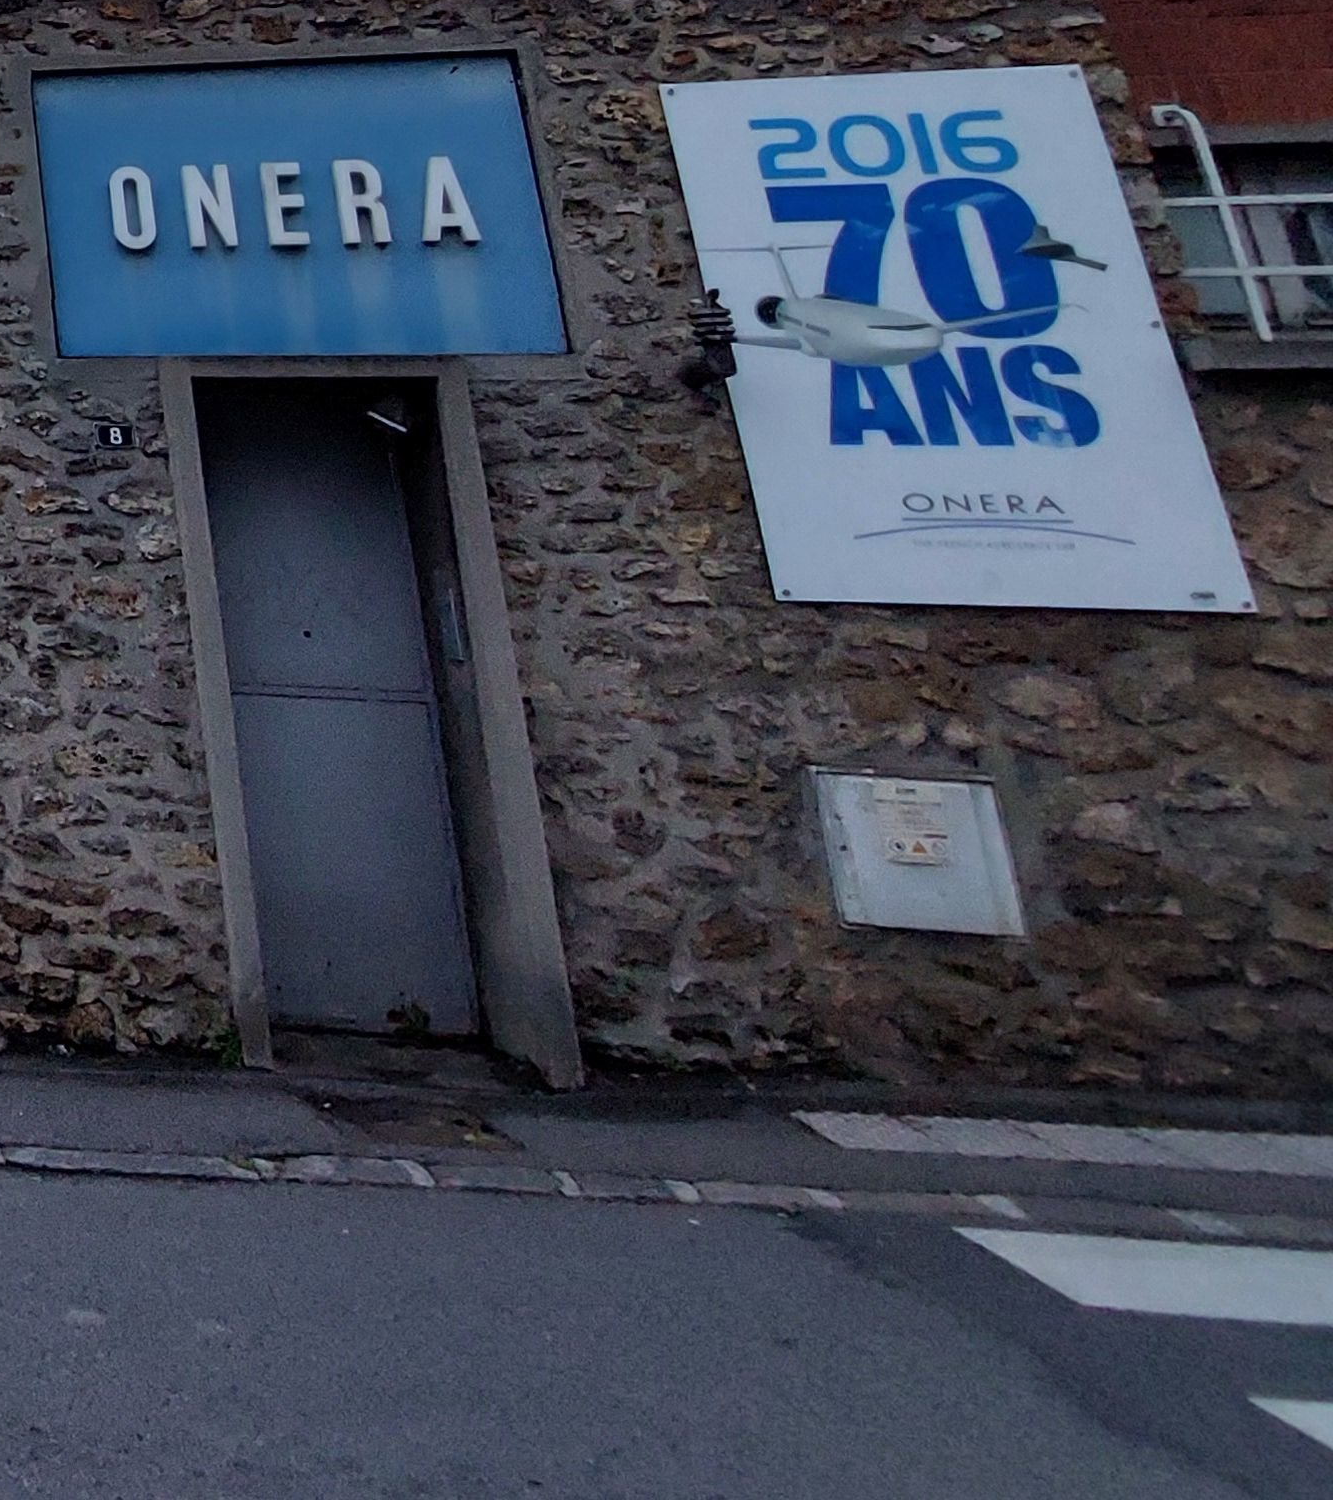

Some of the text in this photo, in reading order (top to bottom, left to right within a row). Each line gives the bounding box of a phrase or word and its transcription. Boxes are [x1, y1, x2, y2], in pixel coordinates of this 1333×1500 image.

[748, 109, 1019, 180] 2016
[108, 155, 483, 251] ONERA
[764, 177, 1060, 339] 70
[109, 426, 123, 445] 8
[829, 343, 1101, 447] ANS
[902, 492, 1066, 514] ONERA
